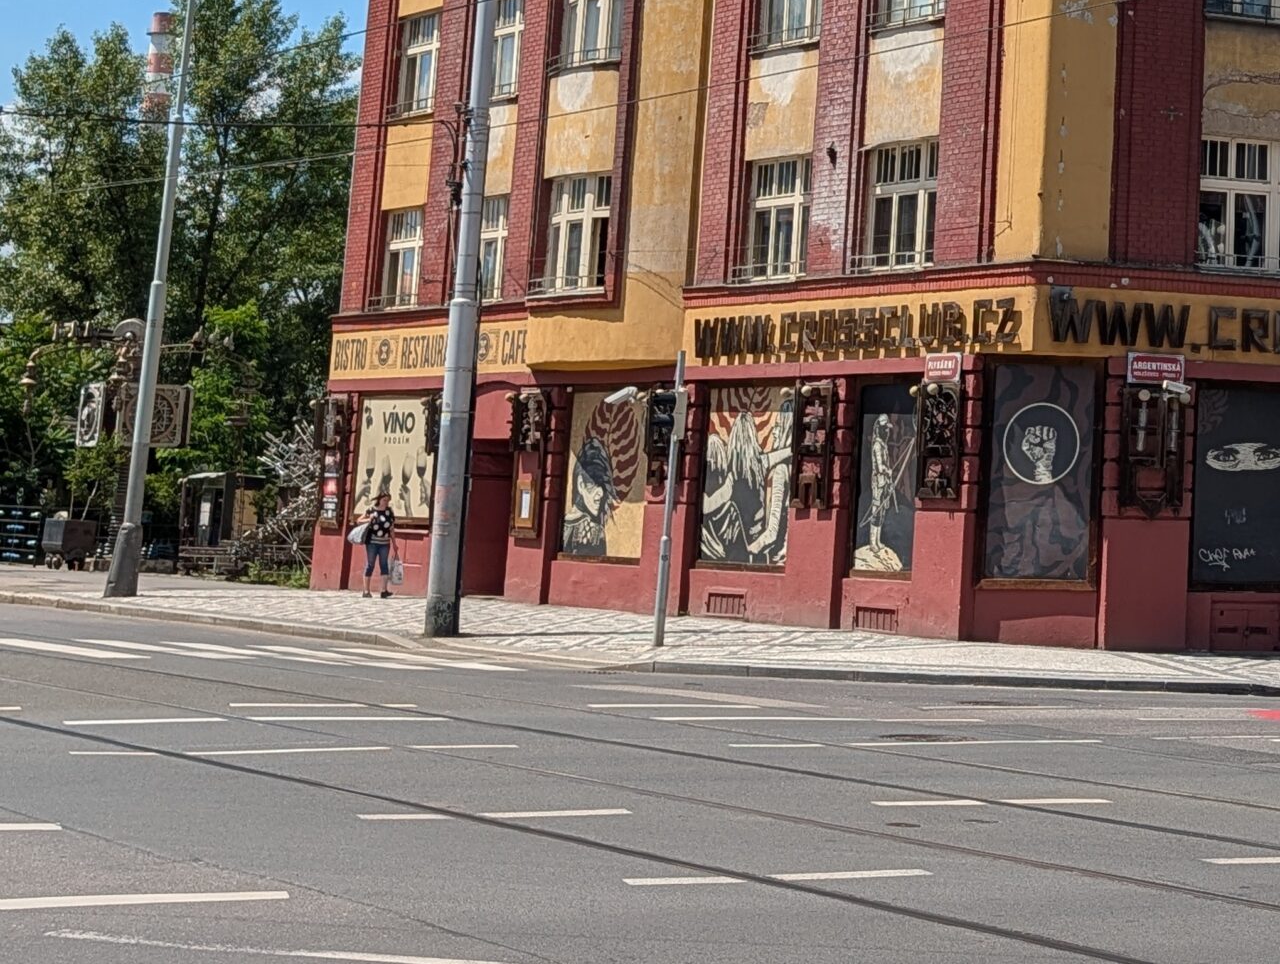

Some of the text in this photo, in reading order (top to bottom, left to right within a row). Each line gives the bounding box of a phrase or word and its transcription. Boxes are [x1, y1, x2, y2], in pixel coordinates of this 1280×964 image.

[695, 297, 1020, 359] WWW.CROSSCLUB.CZ
[334, 338, 368, 371] BISTRO
[400, 333, 449, 370] RESTAUR
[1132, 360, 1181, 372] ARGENTINSKÁ
[382, 404, 416, 434] VÍNO
